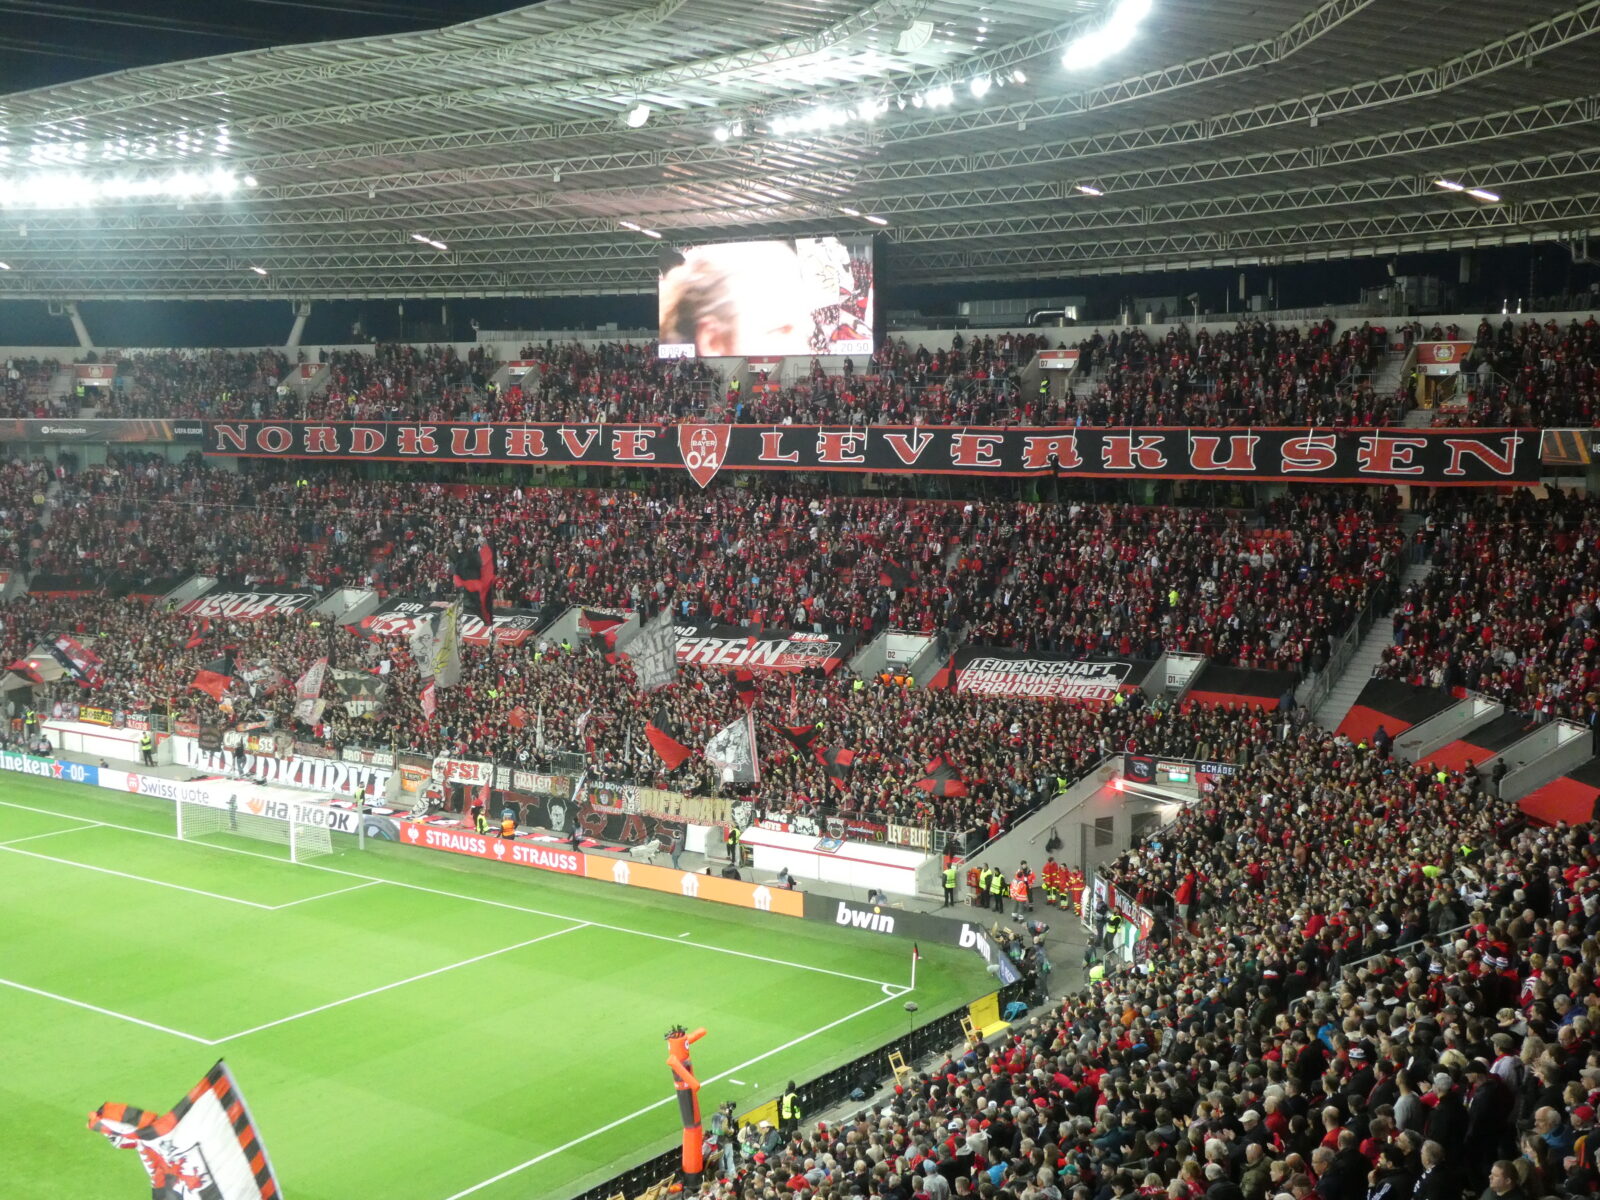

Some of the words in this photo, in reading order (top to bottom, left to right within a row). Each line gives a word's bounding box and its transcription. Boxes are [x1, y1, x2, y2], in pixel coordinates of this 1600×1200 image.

[215, 424, 656, 461] NORDKURVE
[686, 451, 719, 470] 04
[758, 431, 1523, 476] LEVERKUSEN
[674, 626, 698, 637] ND
[674, 637, 790, 665] EREIN
[964, 669, 1080, 686] EMOTIONEN
[972, 658, 1117, 676] LEIDENSCHAFT
[958, 680, 1118, 699] VERBUNDENHEIT
[446, 760, 481, 781] FSI
[426, 830, 486, 855] STRAUSS
[513, 845, 577, 871] STRAUSS
[836, 902, 895, 933] bwin
